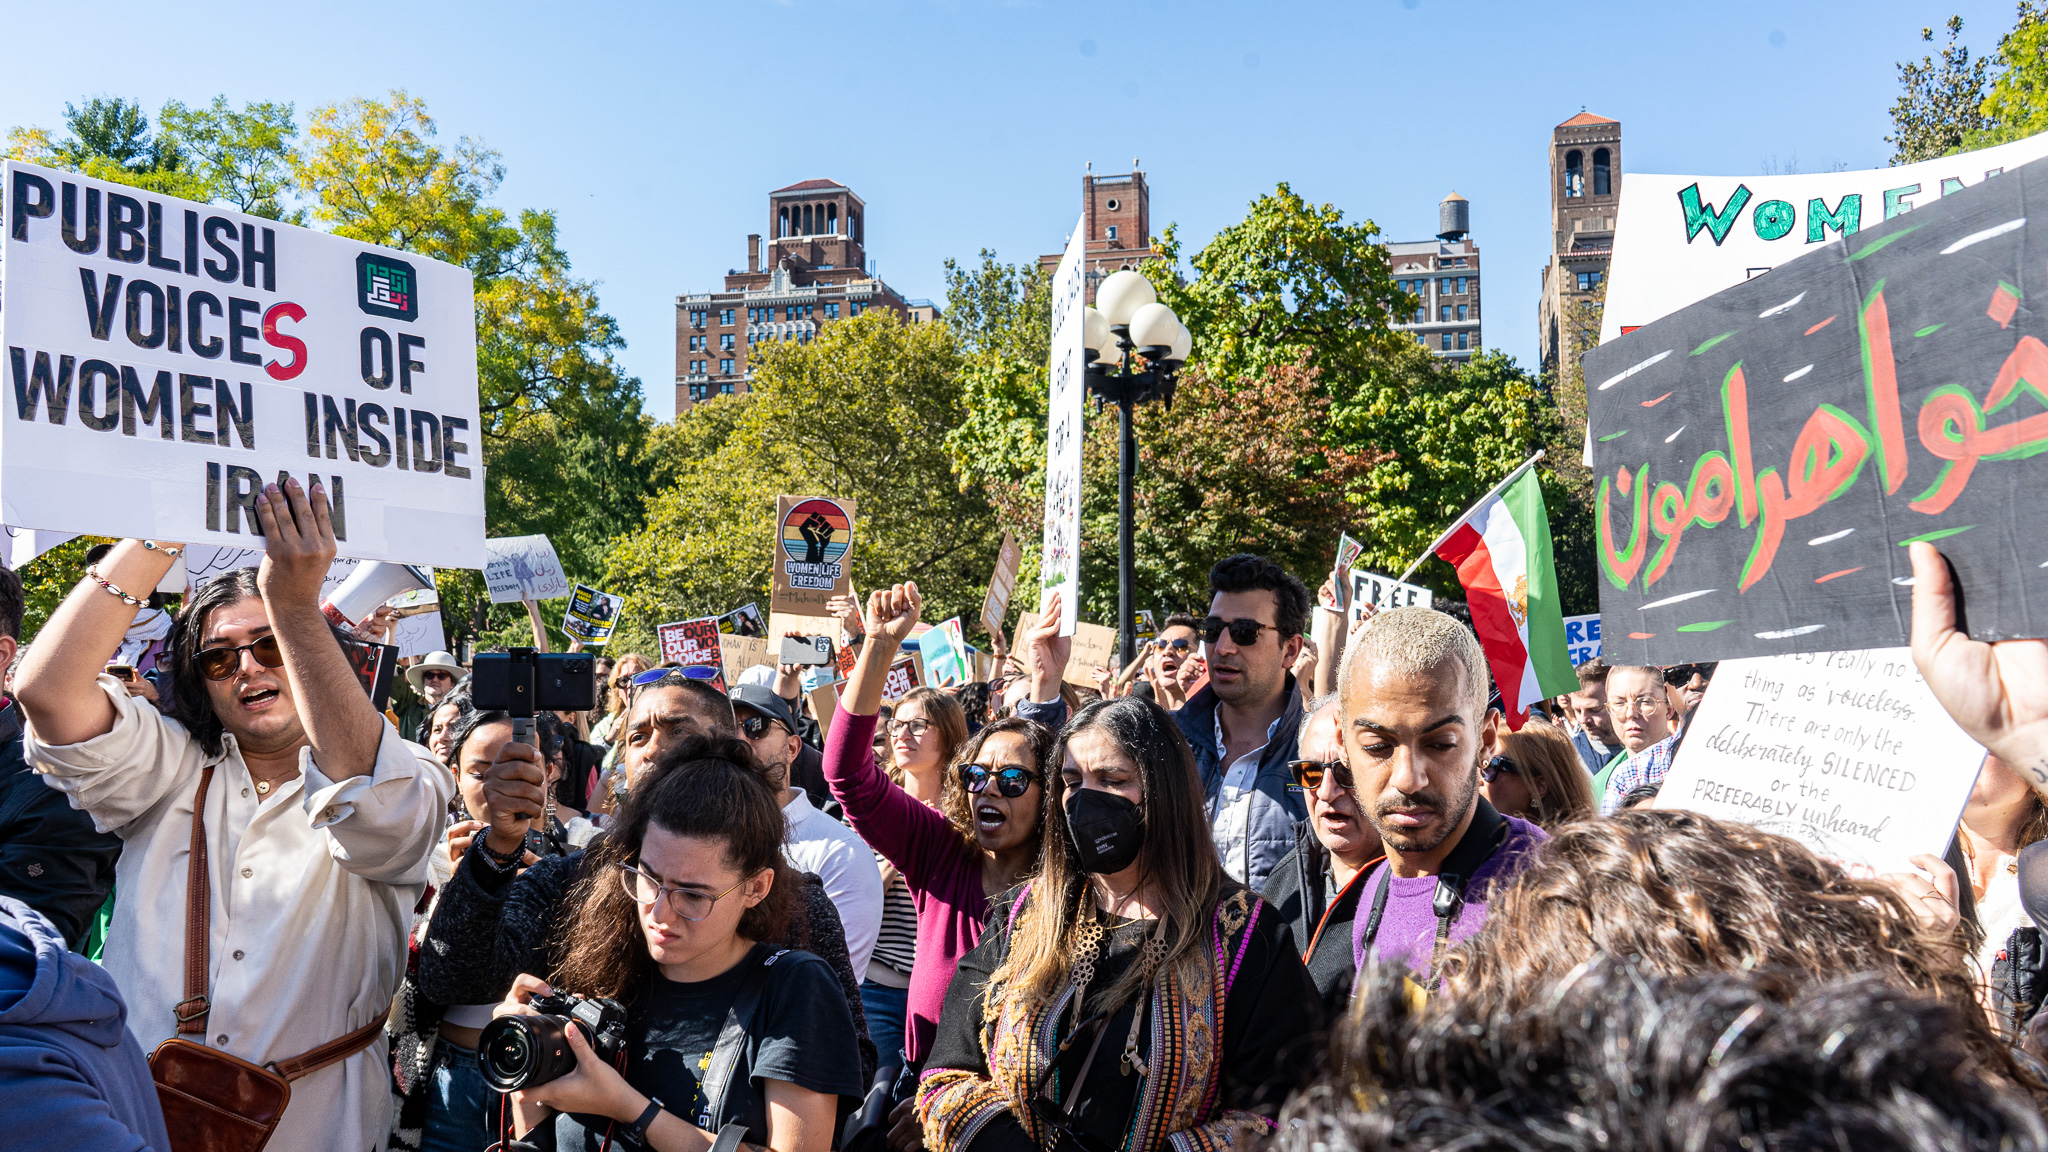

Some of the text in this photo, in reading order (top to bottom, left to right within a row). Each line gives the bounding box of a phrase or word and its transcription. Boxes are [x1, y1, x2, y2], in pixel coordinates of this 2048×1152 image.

[11, 169, 277, 293] PUBLISH
[78, 266, 426, 395] VOICES OF
[8, 345, 473, 480] WOMEN INSIDE
[487, 569, 513, 581] LIFE
[786, 561, 842, 577] WOMEN LIFE
[489, 583, 521, 595] FREEDOM
[791, 574, 833, 589] FREEDOM
[1354, 575, 1418, 608] FREE
[664, 628, 686, 643] BE
[1566, 619, 1601, 645] RE
[666, 639, 698, 655] OUR
[668, 648, 713, 664] VOICE
[749, 641, 758, 652] IS
[736, 655, 751, 668] ALL
[1826, 649, 1877, 679] really
[1883, 661, 1907, 678] no
[1743, 669, 1785, 701] thing
[1797, 684, 1816, 702] as
[1746, 701, 1903, 755] There are only the
[1705, 724, 1917, 792] deliberately SILENCED
[1770, 779, 1830, 802] or the
[1692, 779, 1891, 843] PREFERABLY unheard
[580, 1007, 597, 1020] SONY
